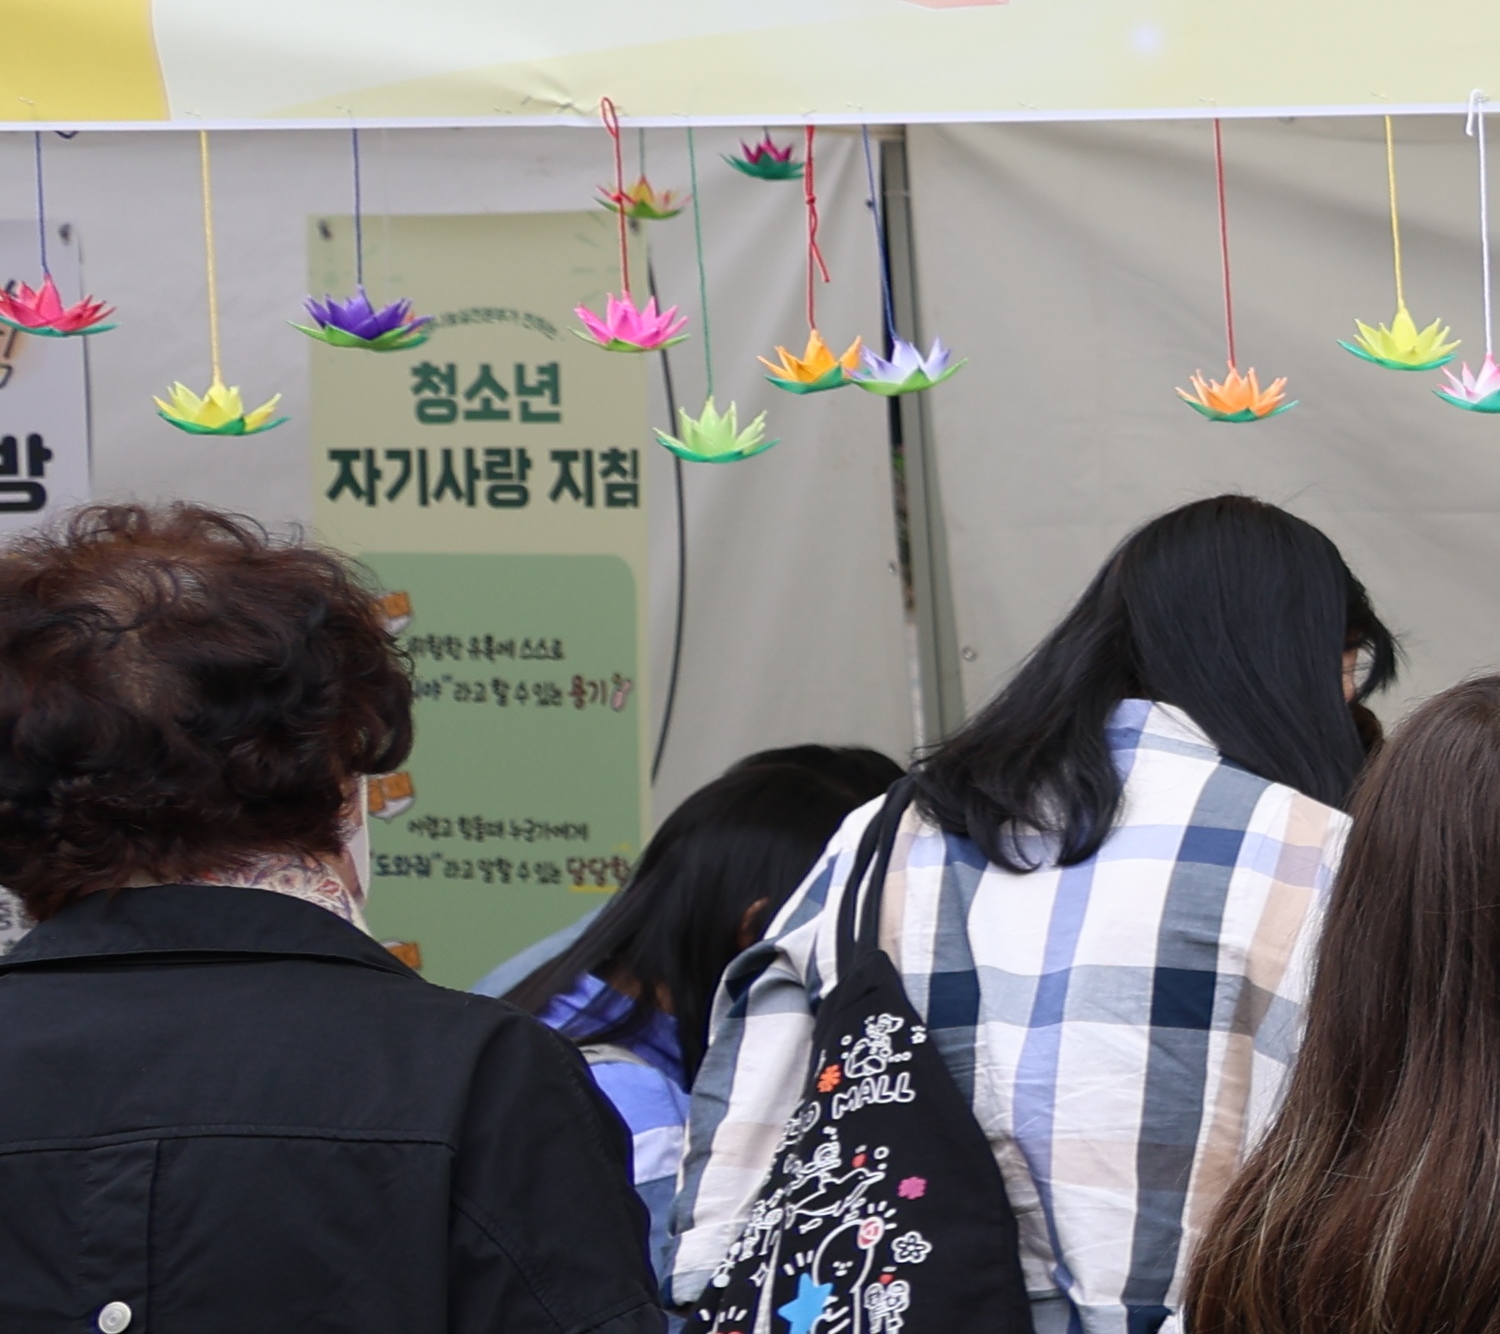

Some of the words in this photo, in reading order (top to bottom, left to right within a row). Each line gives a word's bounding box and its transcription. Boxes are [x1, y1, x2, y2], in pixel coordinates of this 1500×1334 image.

[411, 361, 562, 424] 청소년
[325, 447, 533, 508] 자기사랑
[549, 447, 640, 508] 지침
[832, 1072, 916, 1119] MALL
